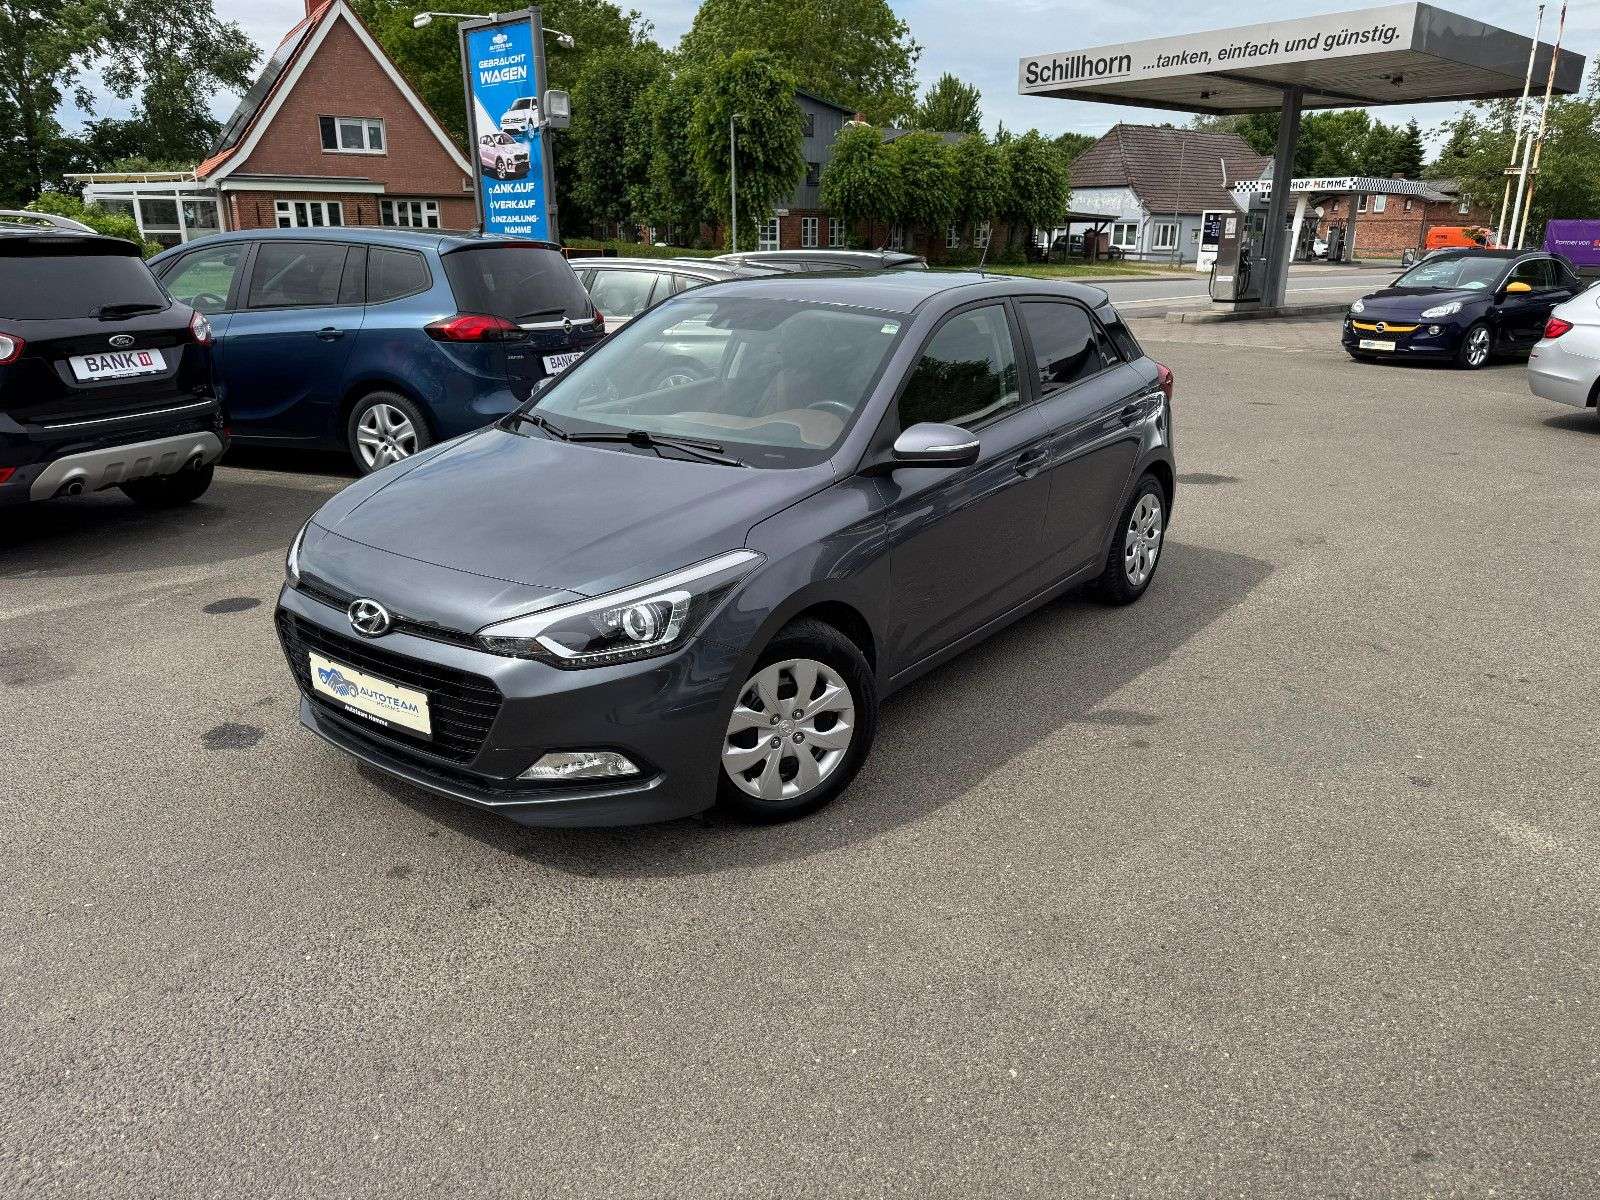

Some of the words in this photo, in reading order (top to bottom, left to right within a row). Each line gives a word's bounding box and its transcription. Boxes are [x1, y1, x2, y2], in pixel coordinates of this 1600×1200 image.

[479, 54, 526, 68] GEBRAUCHT
[1025, 54, 1132, 85] Schillhorn
[1217, 39, 1279, 61] einfach
[1284, 33, 1320, 53] und
[1323, 23, 1400, 52] günstig.
[480, 65, 527, 84] WAGEN
[493, 182, 535, 194] ANKAUF
[493, 199, 536, 210] VERKAUF
[504, 225, 532, 234] NAHME
[84, 352, 139, 373] BANK
[549, 354, 574, 369] BANK
[360, 686, 419, 713] AUTOTEAM
